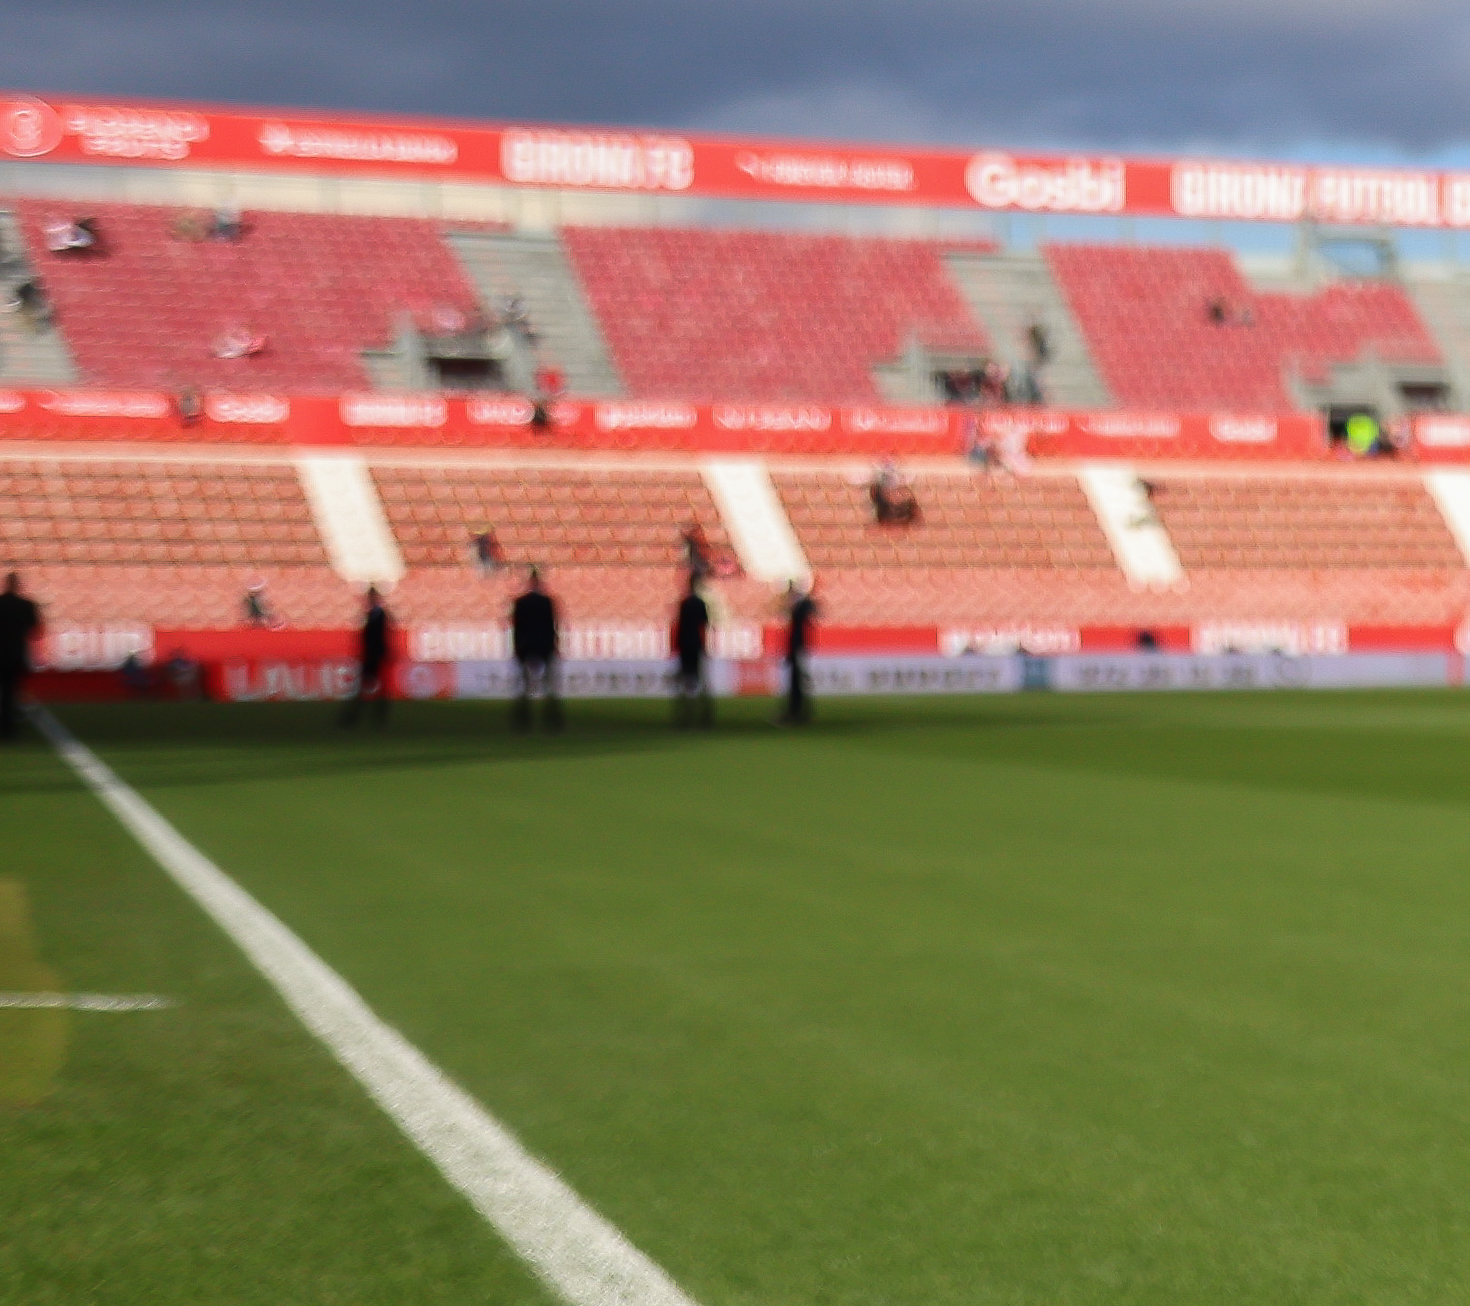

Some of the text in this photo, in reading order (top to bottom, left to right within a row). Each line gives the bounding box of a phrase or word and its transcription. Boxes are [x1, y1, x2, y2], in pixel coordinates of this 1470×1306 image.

[502, 127, 640, 187] GIRONA
[966, 152, 1125, 212] Gosbi
[1170, 161, 1306, 221] GIRONA
